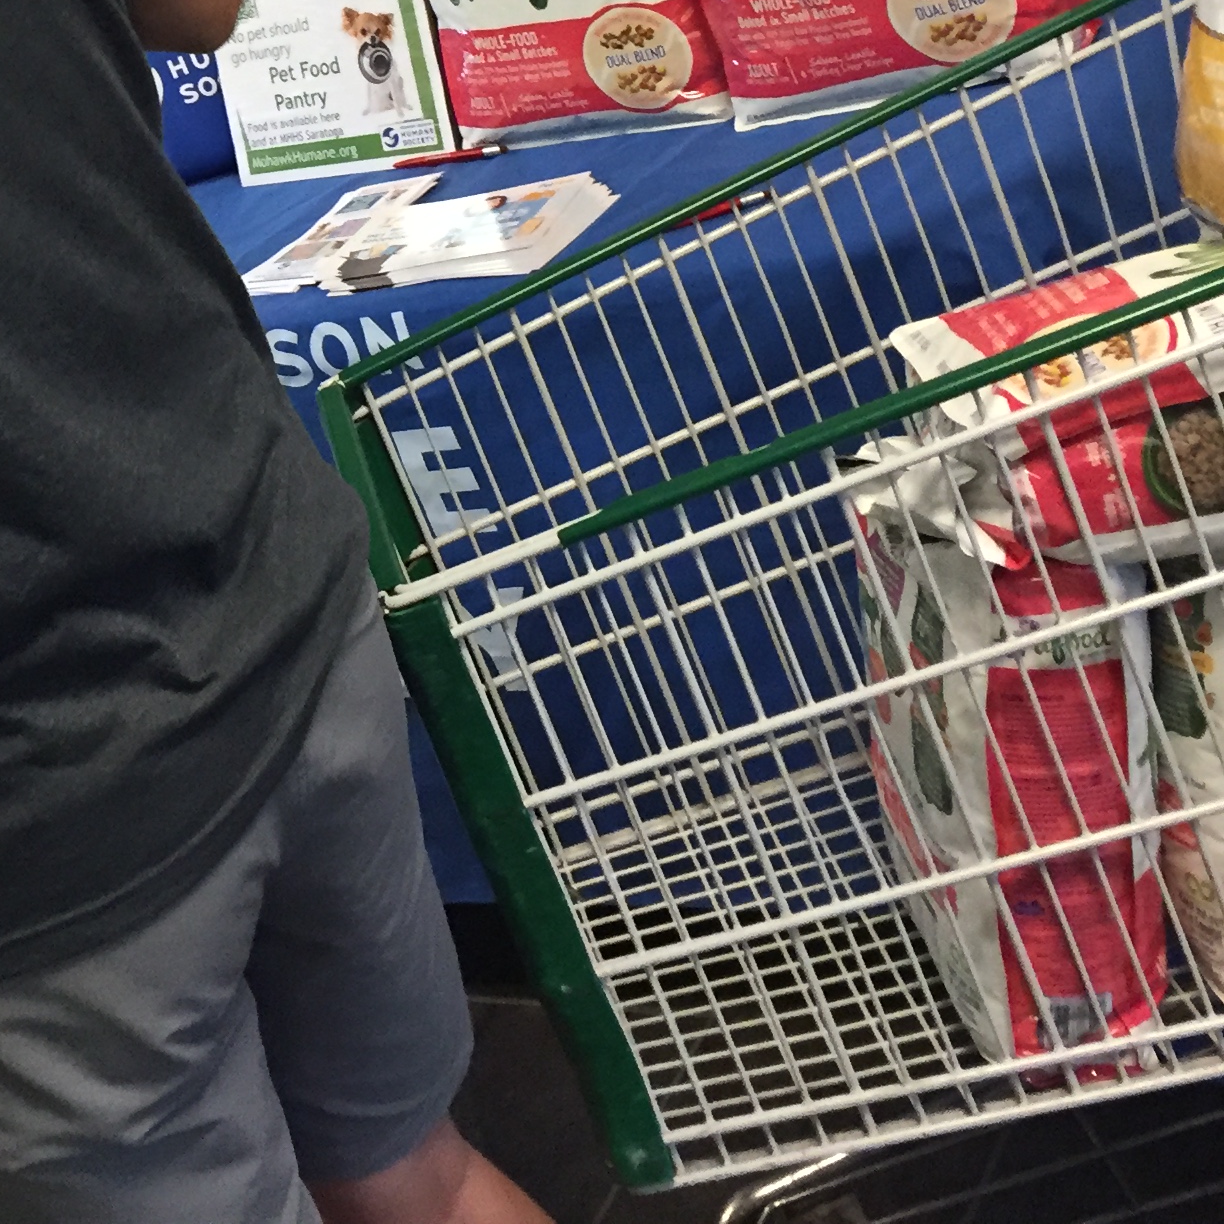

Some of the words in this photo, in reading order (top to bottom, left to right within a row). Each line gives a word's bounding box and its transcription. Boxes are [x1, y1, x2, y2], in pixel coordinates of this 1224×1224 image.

[781, 8, 811, 24] Small
[915, 4, 947, 21] DUAL
[247, 26, 267, 43] pet
[269, 16, 310, 38] should
[231, 52, 248, 69] go
[248, 45, 291, 62] hungry
[605, 53, 632, 69] DUAL
[633, 44, 667, 64] BLEND
[269, 65, 297, 84] Pet
[299, 55, 341, 79] Food
[274, 91, 327, 112] Pantry
[248, 122, 269, 133] Food
[280, 115, 318, 129] available
[319, 112, 341, 122] here
[306, 126, 345, 140] Saratoga
[252, 145, 359, 169] MohawkHumane.org
